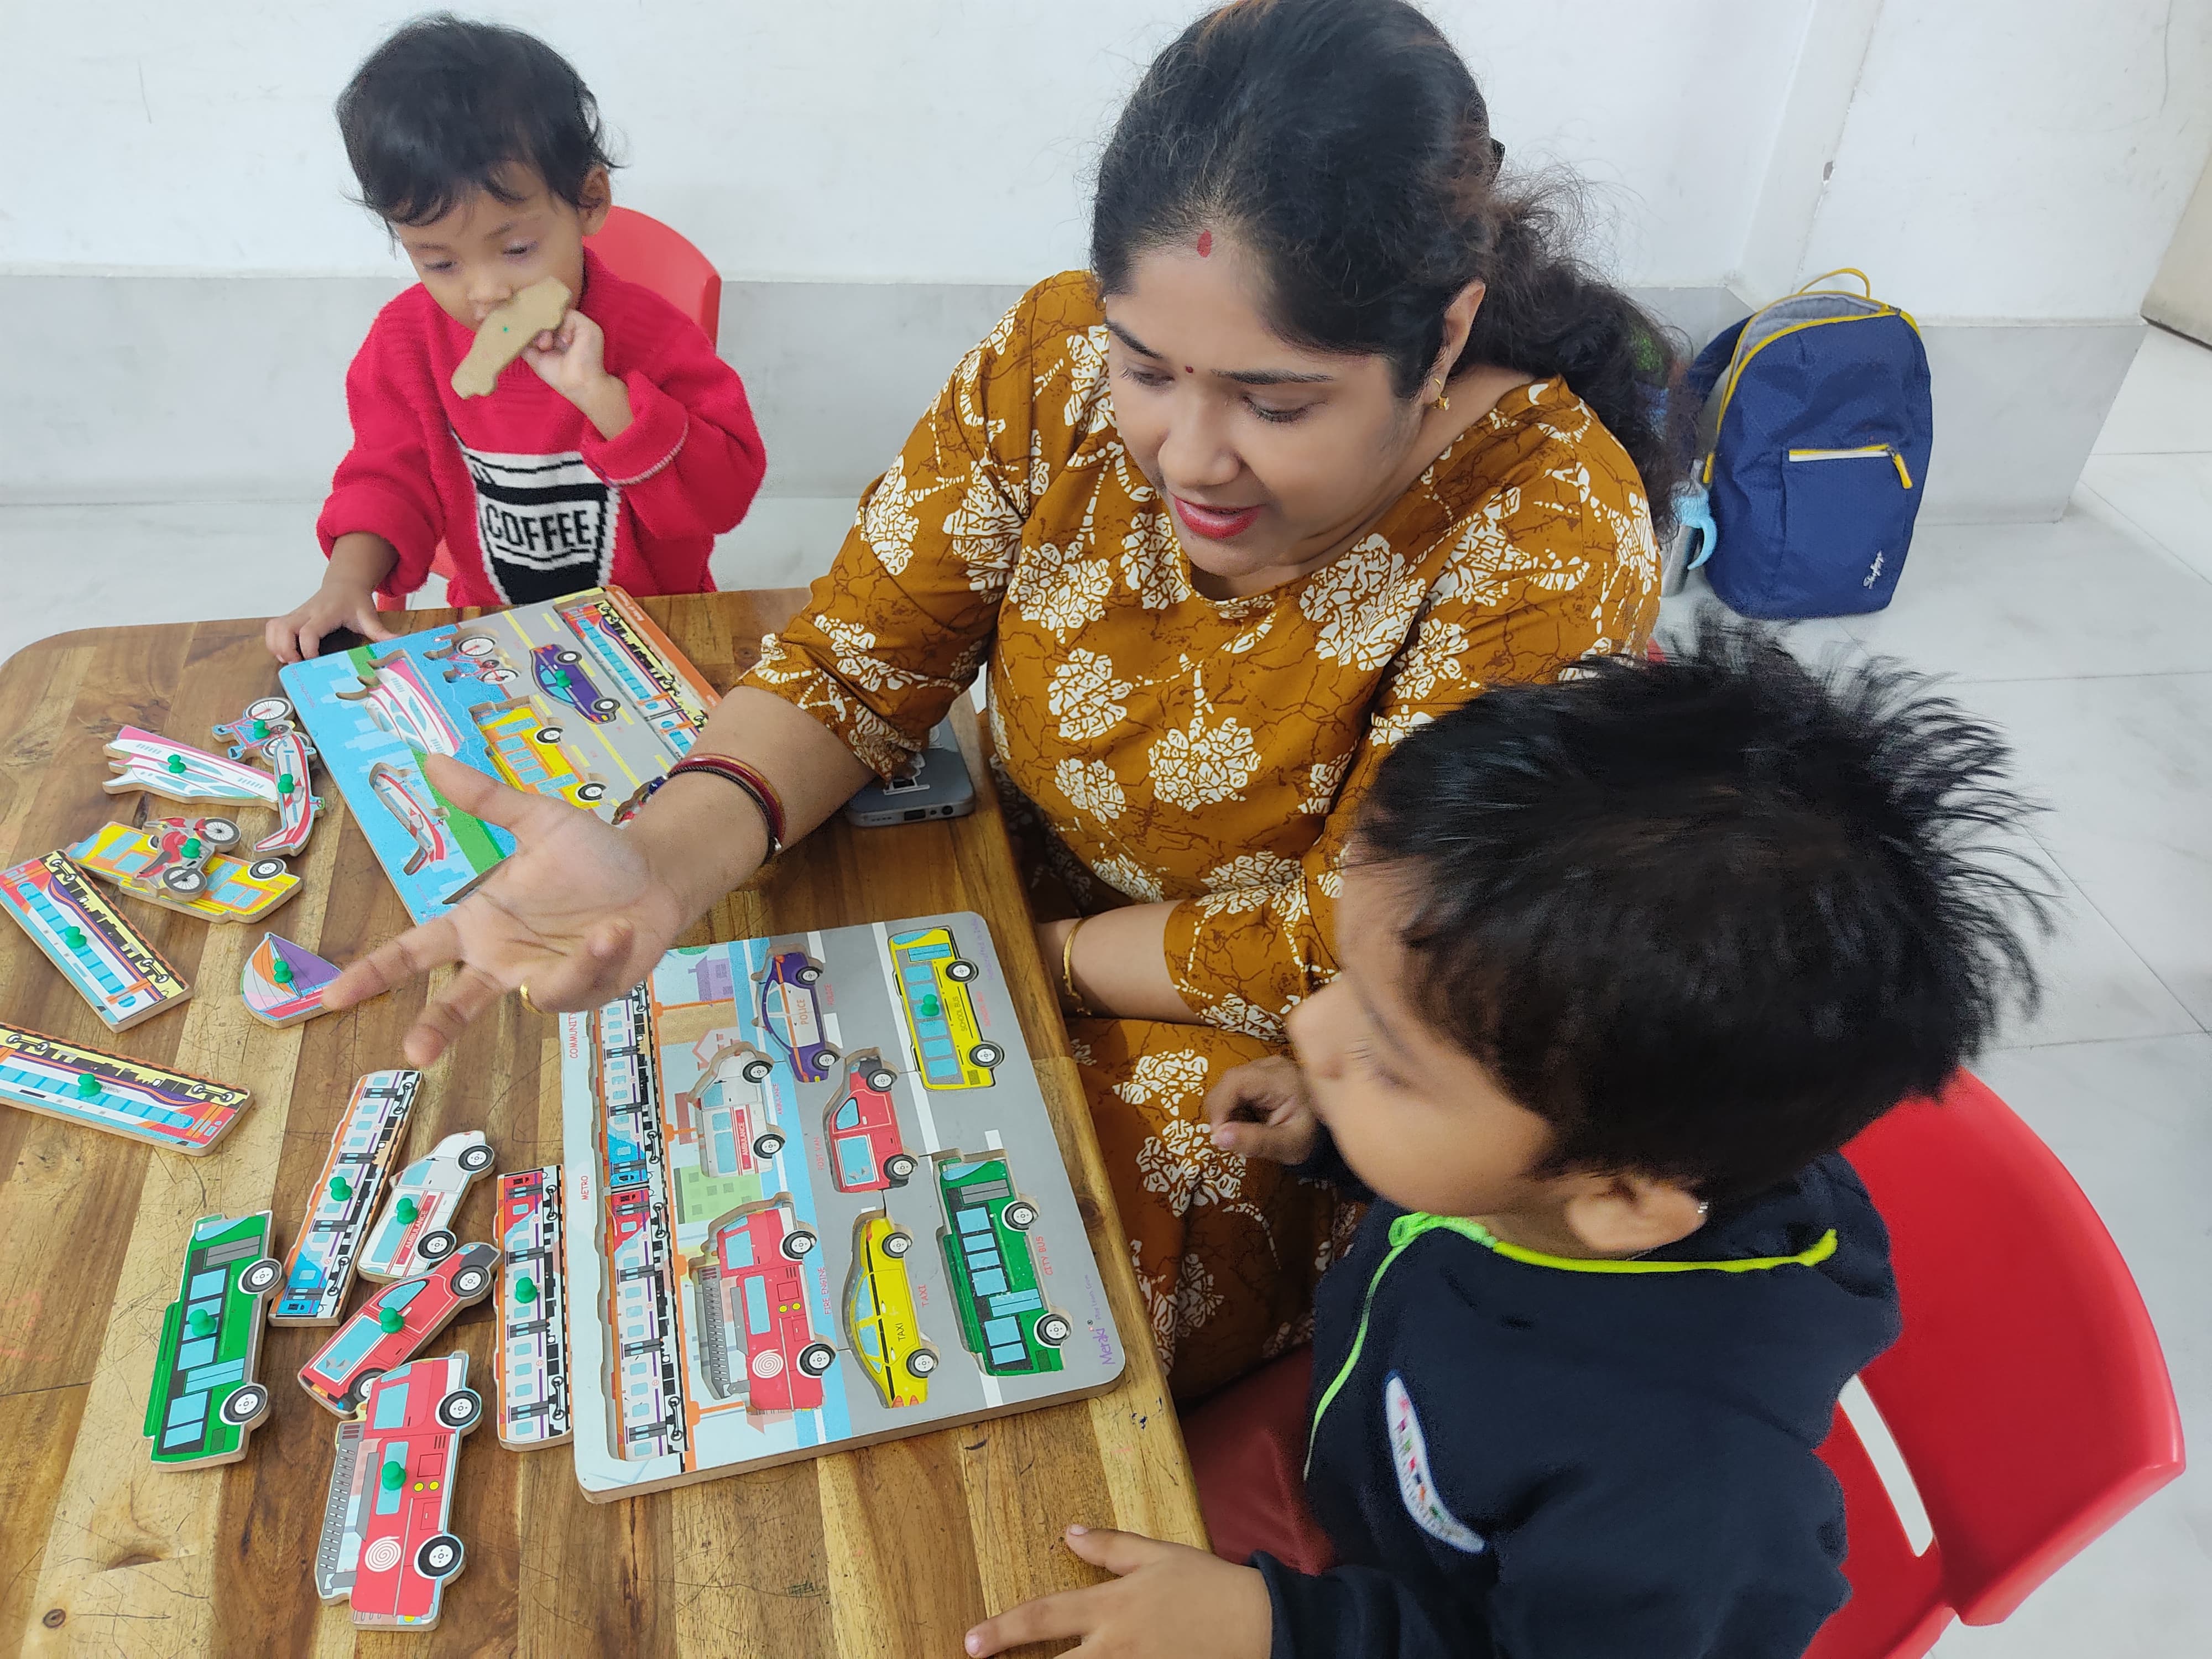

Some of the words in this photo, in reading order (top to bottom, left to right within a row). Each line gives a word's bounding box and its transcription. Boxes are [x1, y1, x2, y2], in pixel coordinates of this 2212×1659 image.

[486, 504, 591, 551] COFFEE
[796, 999, 810, 1025] POLICE
[952, 996, 961, 1008] BUS
[957, 1009, 968, 1031] SCHOOL
[738, 1122, 749, 1156] AMBULANCE
[815, 1154, 825, 1170] POST
[581, 1176, 589, 1200] METRO
[405, 1210, 427, 1249] AMBULANCE
[1036, 1236, 1047, 1254] BUS
[1040, 1255, 1052, 1276] CITY
[818, 1267, 828, 1295] ENGINE
[822, 1297, 832, 1314] FIRE
[918, 1284, 929, 1307] TAXI
[895, 1323, 906, 1342] TAXI
[1092, 1328, 1115, 1365] Meraki
